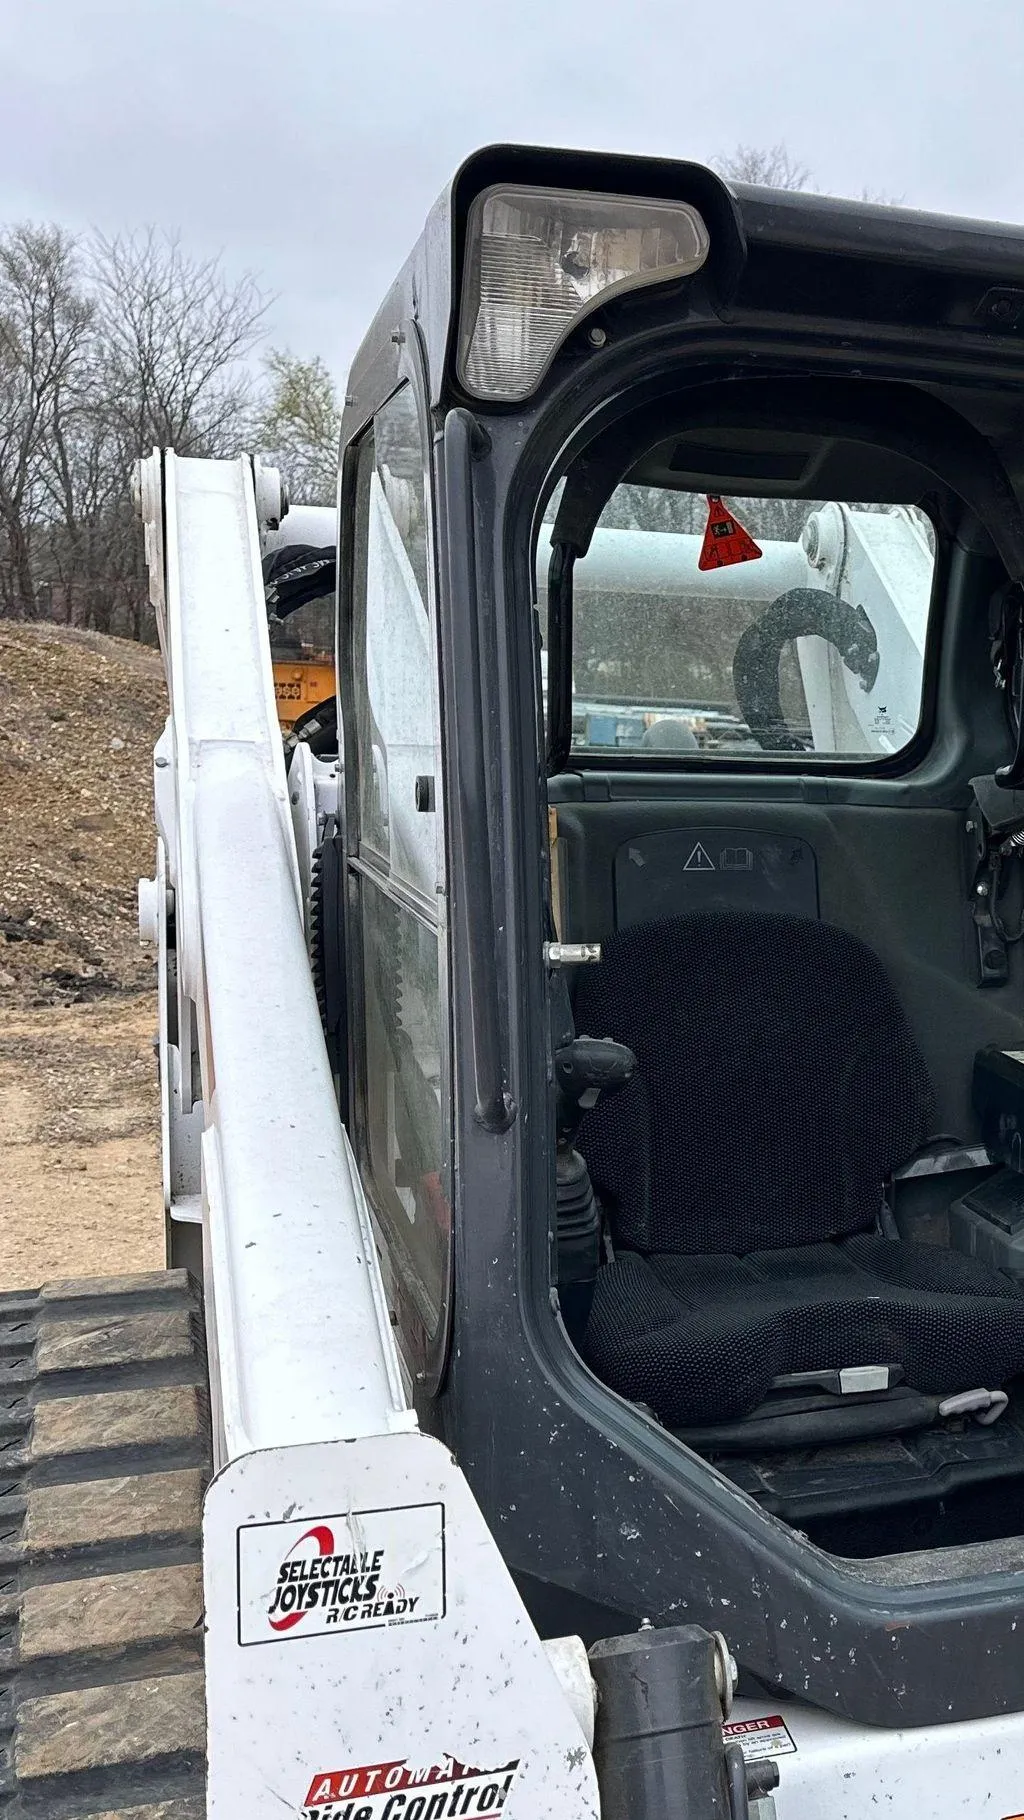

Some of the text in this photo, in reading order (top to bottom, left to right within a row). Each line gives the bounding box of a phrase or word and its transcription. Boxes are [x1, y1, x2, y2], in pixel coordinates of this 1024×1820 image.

[267, 1574, 380, 1614] JOYSTICKS
[325, 1605, 359, 1624] R/C
[361, 1596, 420, 1620] READY
[721, 1720, 770, 1736] NGER
[382, 1774, 513, 1820] Control
